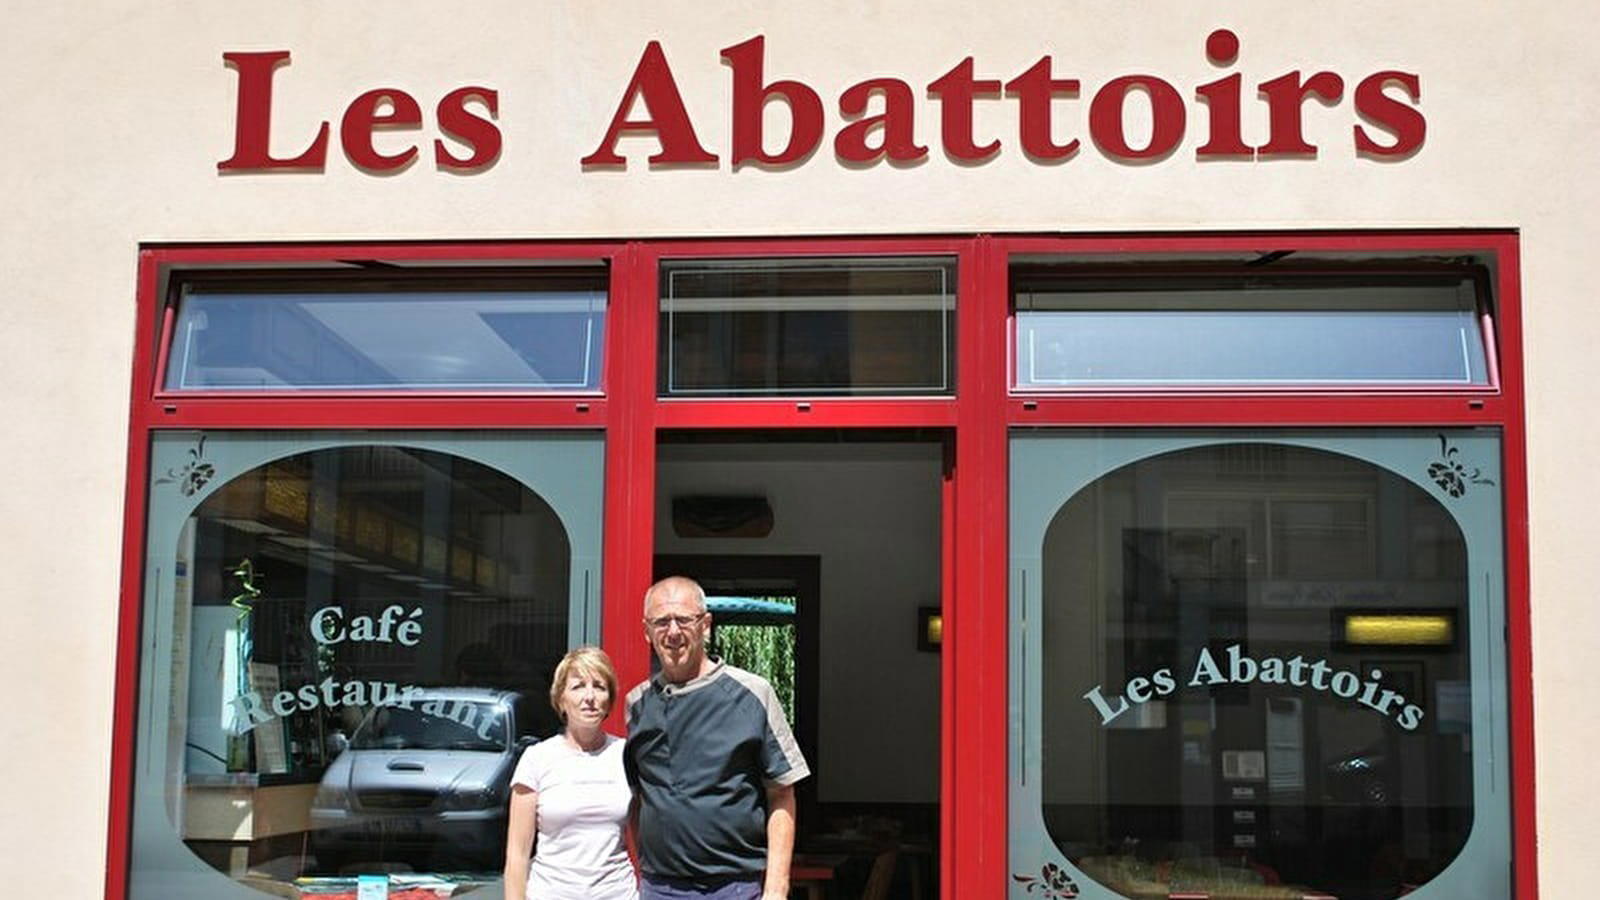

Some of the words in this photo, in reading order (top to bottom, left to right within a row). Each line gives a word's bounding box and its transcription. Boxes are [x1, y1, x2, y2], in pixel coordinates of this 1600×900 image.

[217, 50, 502, 173] Les
[580, 29, 1427, 167] Abattoirs
[310, 605, 423, 646] Café
[228, 676, 502, 742] Restaurant
[1084, 668, 1176, 726] Les
[1188, 644, 1425, 732] Abattoirs
